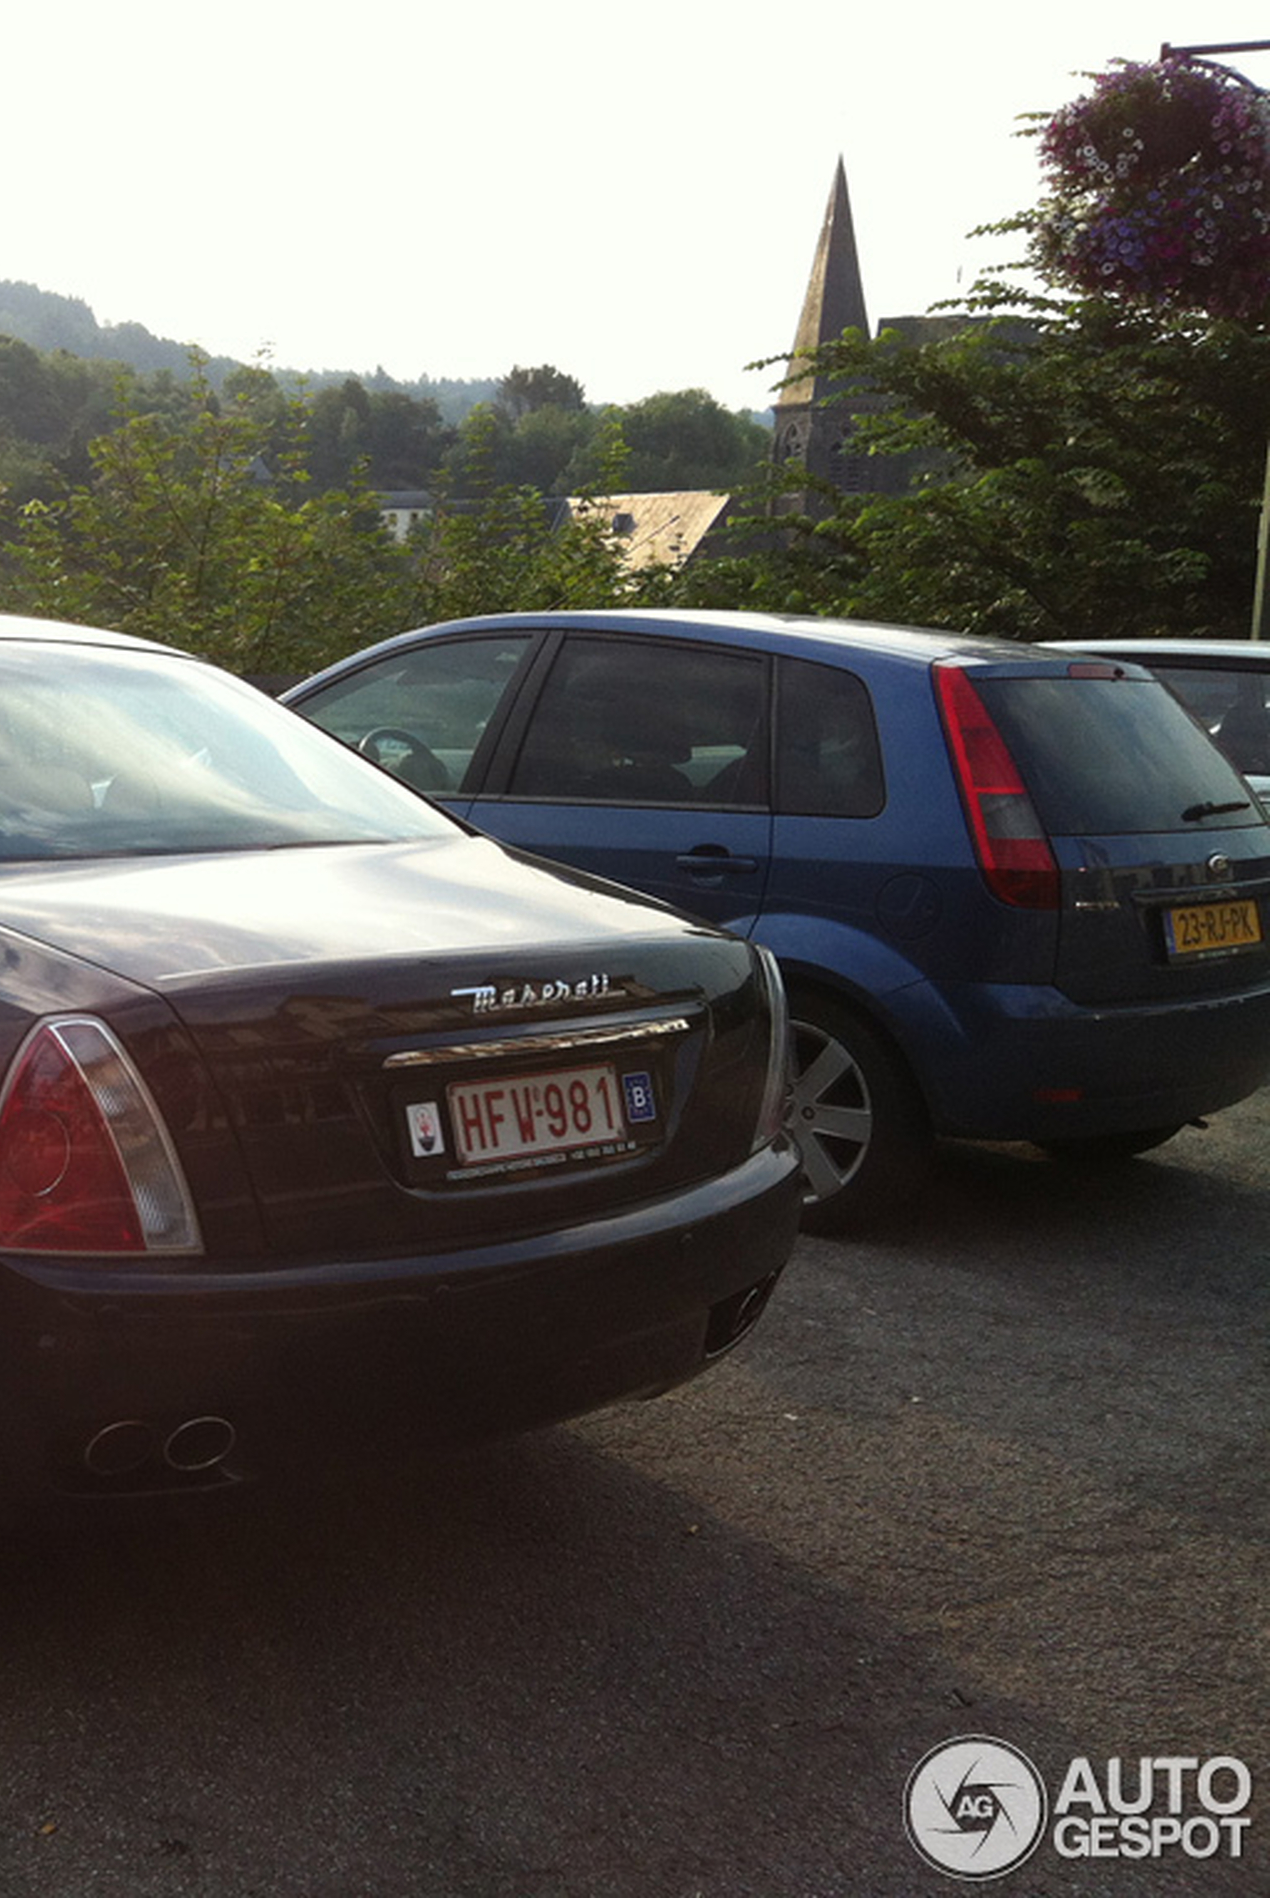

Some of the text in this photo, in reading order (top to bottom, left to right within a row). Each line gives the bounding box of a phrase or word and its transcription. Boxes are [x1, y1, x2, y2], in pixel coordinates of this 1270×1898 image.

[1178, 905, 1254, 946] 23-RJ-PK
[450, 973, 627, 1014] Maserati
[631, 1085, 647, 1108] B
